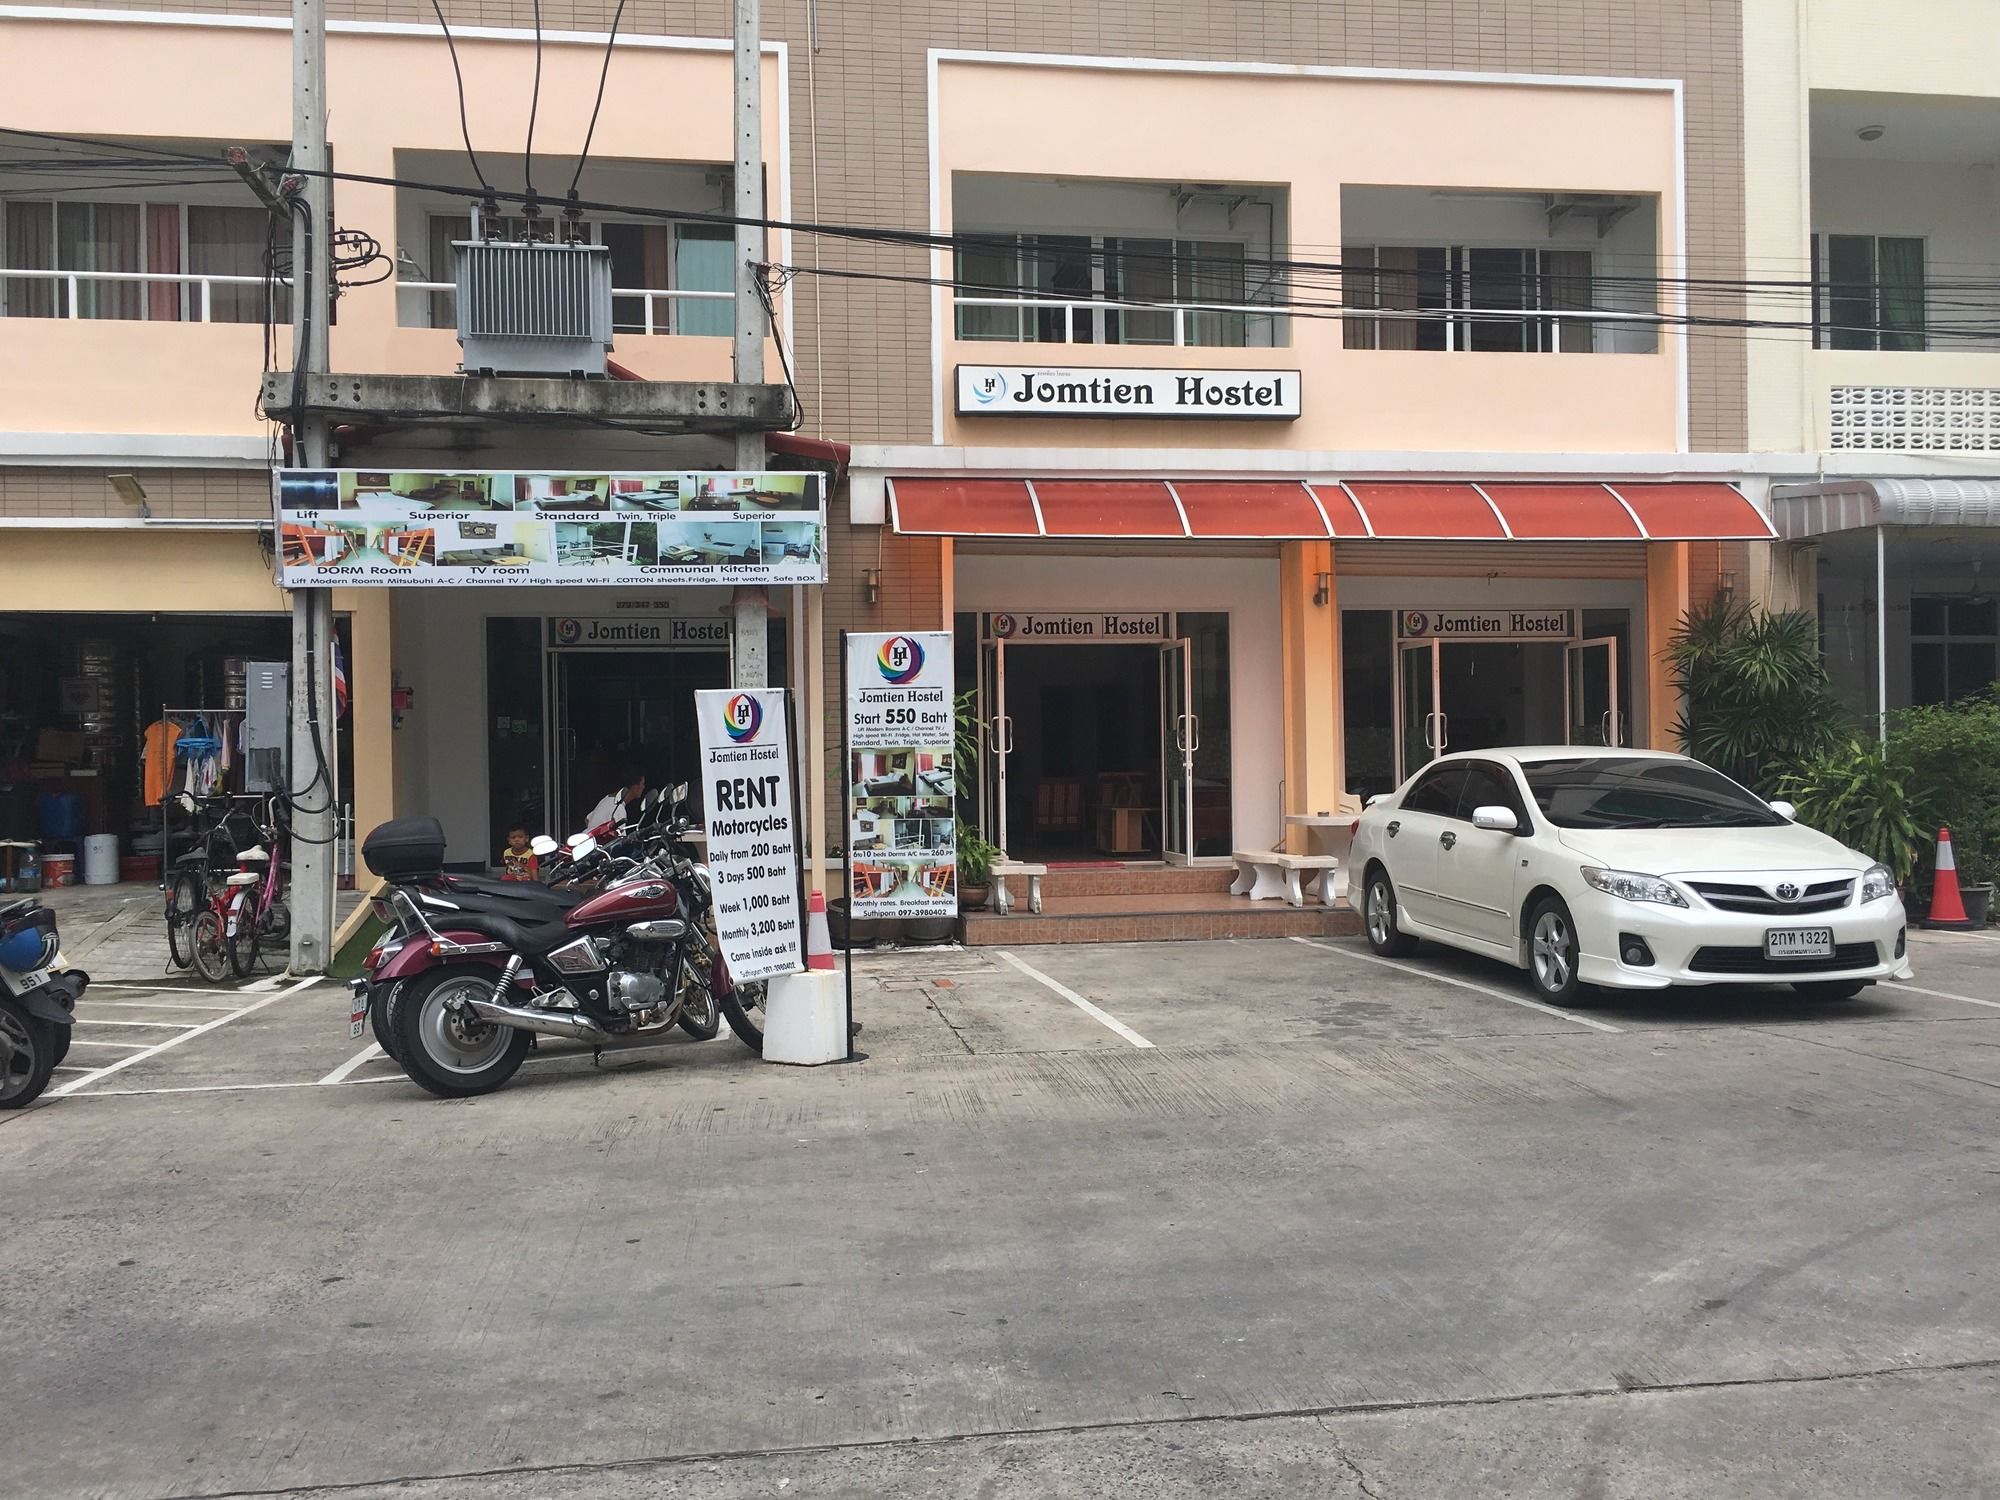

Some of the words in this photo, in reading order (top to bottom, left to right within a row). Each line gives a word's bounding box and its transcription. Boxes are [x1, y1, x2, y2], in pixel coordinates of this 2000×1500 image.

[1013, 373, 1154, 405] Jomtien
[1175, 376, 1284, 407] Hostel
[296, 510, 319, 520] Lift
[409, 511, 470, 521] Superior
[535, 512, 600, 520] Standard
[616, 512, 643, 522] Twin,
[648, 512, 676, 521] Triple
[732, 512, 776, 522] Superior
[317, 566, 364, 575] DORM
[370, 566, 412, 574] Room
[470, 566, 487, 574] TV
[640, 566, 714, 574] Communal
[720, 565, 770, 573] Kitchen
[555, 577, 582, 585] speed
[588, 621, 660, 640] Jomtien
[672, 620, 730, 640] Hostel
[1022, 616, 1094, 634] Jomtien
[1104, 616, 1160, 634] Hostel
[1434, 614, 1502, 632] Jomtien
[1511, 613, 1564, 632] Hostel
[859, 692, 904, 704] Jomtien
[907, 690, 944, 702] Hostel
[854, 712, 881, 725] Start
[885, 708, 916, 724] 550
[921, 712, 948, 724] Baht
[709, 751, 748, 764] Jomtien
[750, 748, 779, 761] Hostel
[716, 776, 781, 812] RENT
[712, 814, 788, 837] Motorcycles
[710, 850, 729, 863] Daily
[730, 849, 749, 860] from
[751, 842, 770, 858] 200
[772, 843, 792, 855] Baht
[718, 870, 724, 884] 3
[726, 872, 745, 884] Days
[746, 866, 766, 881] 500
[768, 866, 786, 878] Baht
[720, 901, 742, 914] Week
[742, 894, 769, 912] 1,000
[772, 894, 790, 906] Baht
[853, 900, 878, 908] Monthly
[863, 910, 896, 918] Suthiporn
[898, 908, 947, 916] 097-3980402
[721, 928, 750, 941] Monthly
[750, 920, 776, 936] 3,200
[778, 920, 795, 931] Baht
[1770, 932, 1796, 946] 2กท
[1799, 931, 1828, 944] 1322
[730, 950, 751, 962] Come
[752, 946, 773, 958] inside
[774, 943, 787, 955] ask
[20, 974, 43, 990] 951
